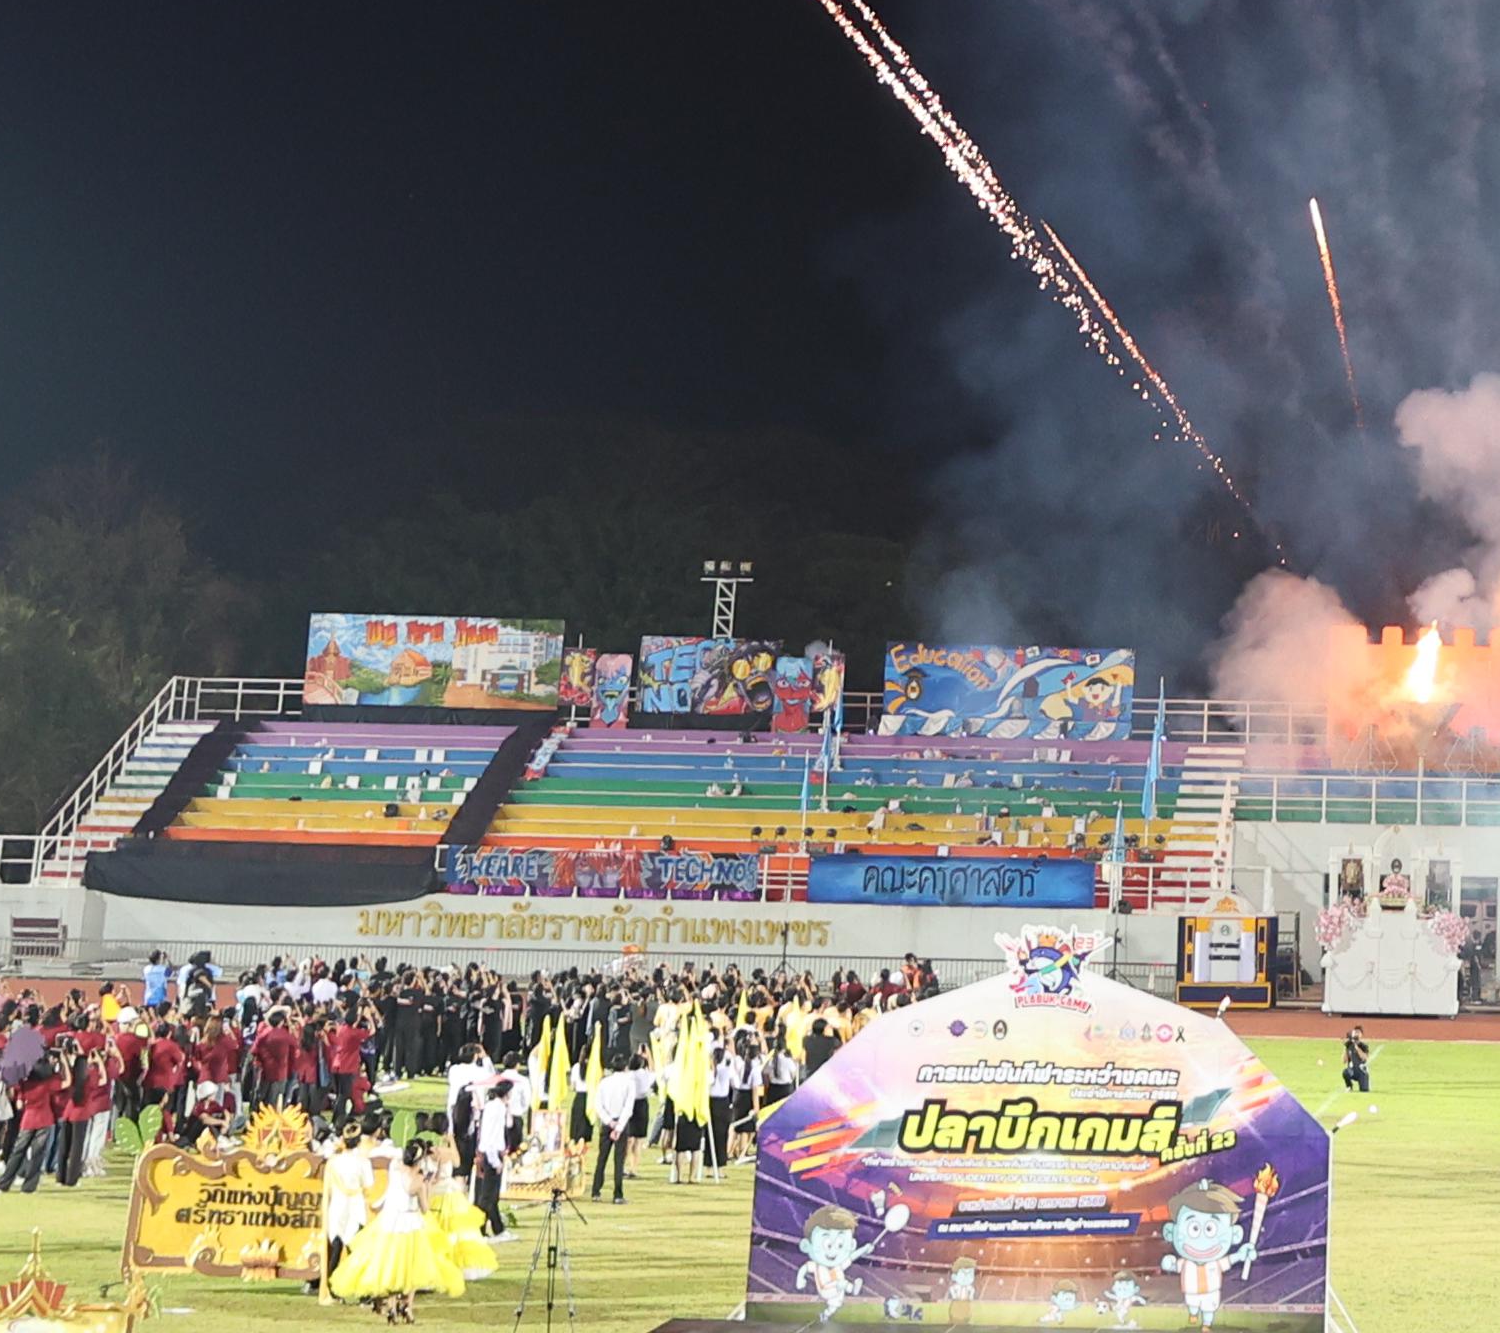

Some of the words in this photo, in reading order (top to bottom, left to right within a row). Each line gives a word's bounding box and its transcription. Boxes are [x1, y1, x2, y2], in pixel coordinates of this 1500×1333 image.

[889, 642, 994, 691] Education
[862, 854, 1049, 901] คณะครุศาสตร์
[900, 1097, 1183, 1156] ปลาบึกเกมส์
[1210, 1130, 1237, 1151] 23
